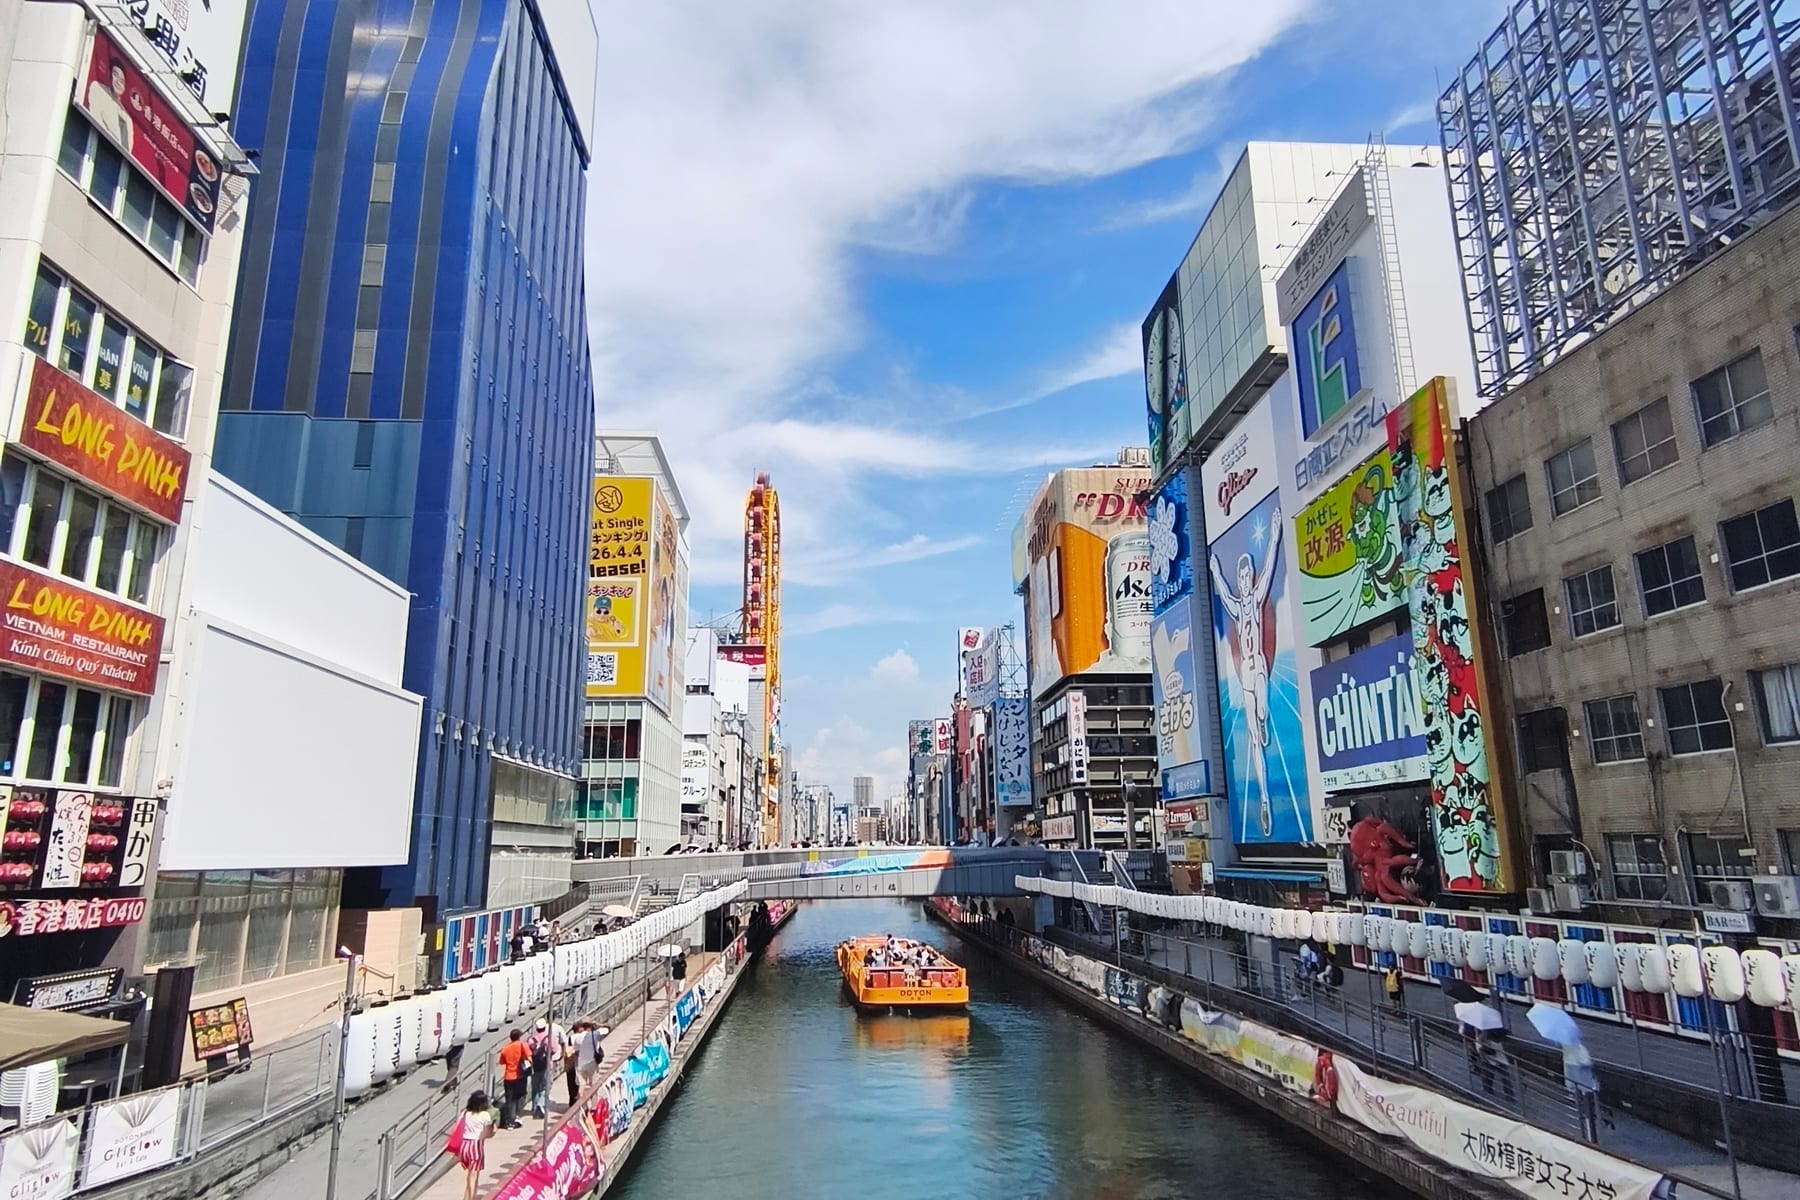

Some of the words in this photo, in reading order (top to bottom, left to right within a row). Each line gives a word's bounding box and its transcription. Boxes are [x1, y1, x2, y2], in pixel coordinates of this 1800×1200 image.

[1290, 222, 1350, 306] エステムシリーズ
[34, 388, 115, 466] LONG
[117, 433, 183, 499] DINH
[1294, 396, 1388, 492] 日商エステム
[1217, 466, 1258, 516] Glico
[607, 516, 644, 530] Single
[1305, 501, 1338, 536] かぜに
[592, 545, 642, 560] 26.4.4
[1304, 518, 1345, 570] 改源
[590, 559, 646, 578] lease!
[7, 578, 86, 627] LONG
[89, 604, 152, 647] DINH
[5, 612, 66, 641] VIETNAM
[73, 633, 148, 665] RESTAURANT
[10, 638, 41, 659] Kính
[43, 647, 74, 667] Chào
[76, 655, 100, 675] Quý
[101, 663, 137, 684] Khách!
[1159, 691, 1194, 736] さける
[1318, 664, 1426, 758] CHINTAI
[998, 702, 1015, 783] だけじゃない
[1010, 699, 1029, 777] シャッター
[125, 801, 155, 884] 串かつ
[1328, 812, 1346, 838] くくる
[839, 882, 897, 893] えびす橋
[16, 897, 105, 936] 香港飯店
[105, 901, 144, 924] 0410
[1706, 915, 1728, 928] BAR
[900, 989, 932, 997] DOTON
[104, 1137, 163, 1162] Gliglow
[1460, 1128, 1617, 1200] 大阪樟蔭女子大学
[10, 1171, 60, 1199] Gliglow
